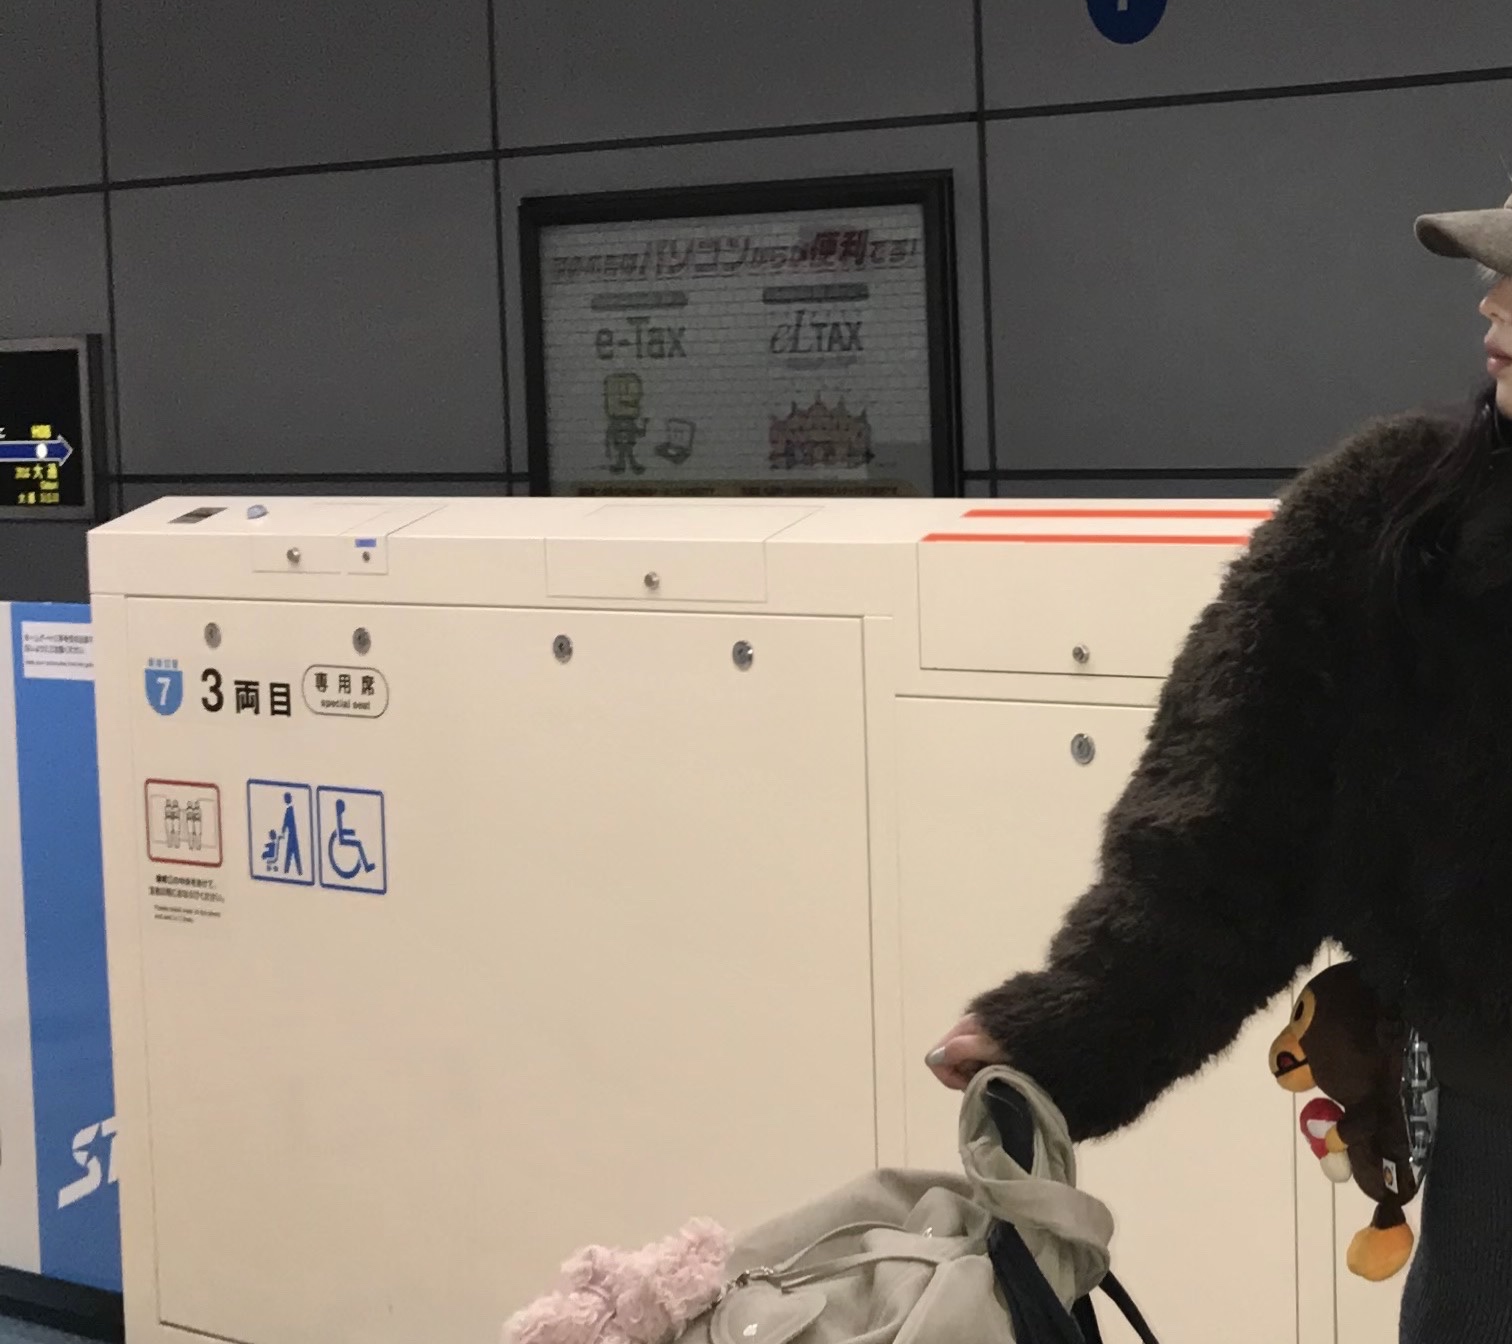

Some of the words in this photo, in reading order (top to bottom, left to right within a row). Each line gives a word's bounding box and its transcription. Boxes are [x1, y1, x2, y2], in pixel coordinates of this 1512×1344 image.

[595, 316, 687, 360] e-Tax
[156, 677, 171, 706] 7
[201, 667, 292, 717] 3両目
[314, 672, 375, 696] 専用席
